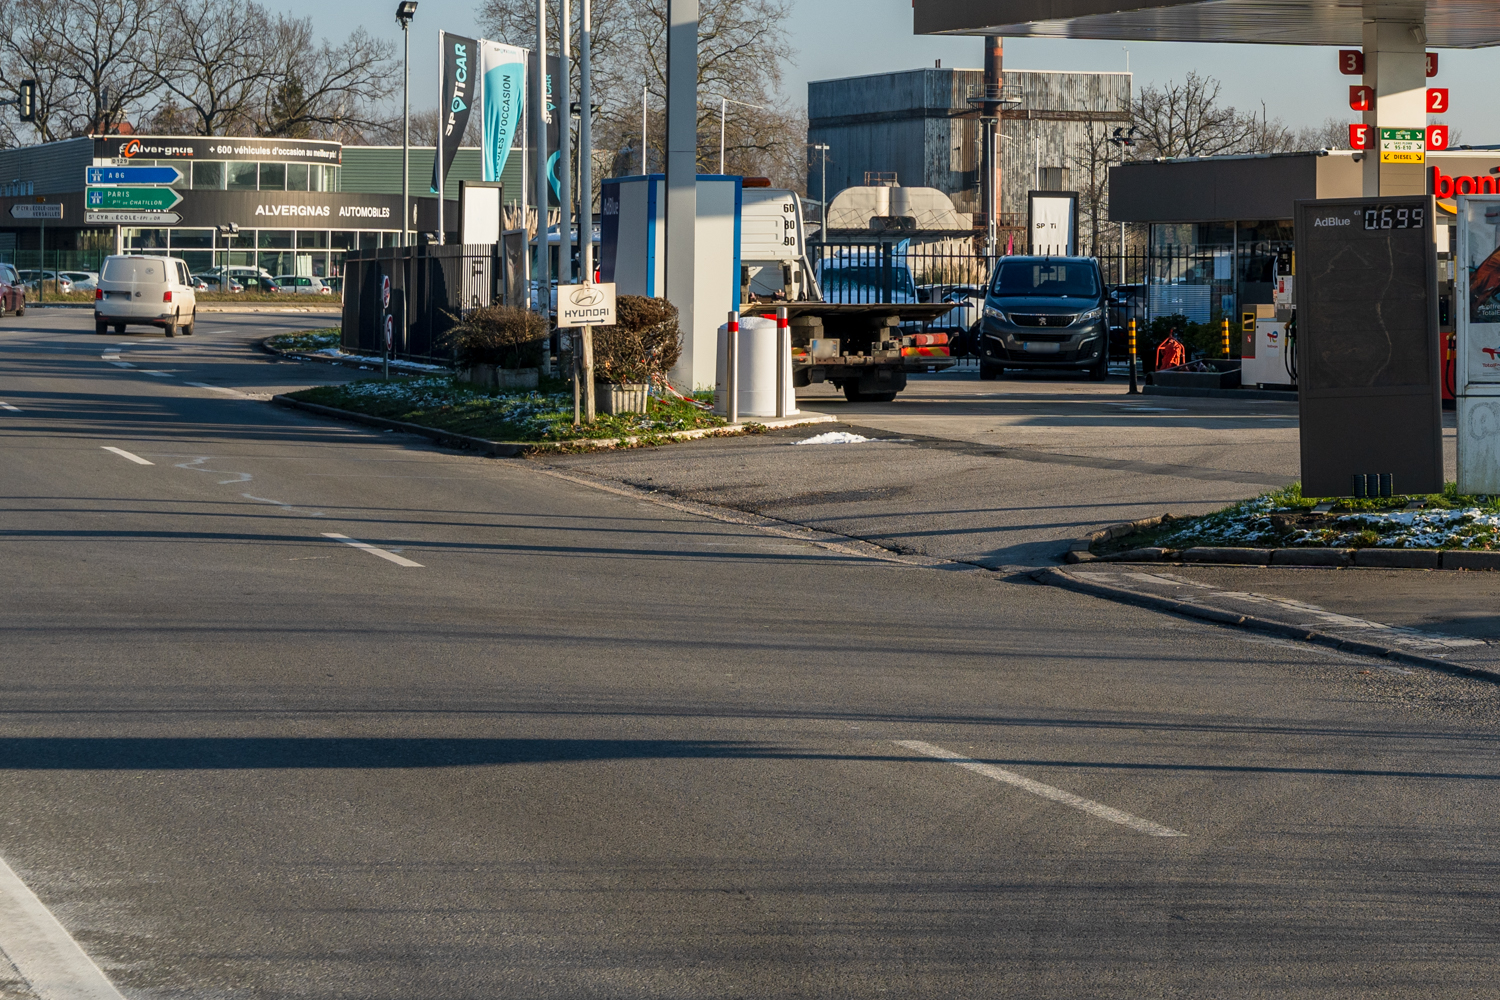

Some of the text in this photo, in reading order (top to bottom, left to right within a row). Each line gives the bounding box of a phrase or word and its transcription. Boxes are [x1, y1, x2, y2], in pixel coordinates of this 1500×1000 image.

[1346, 54, 1357, 71] 3
[1426, 56, 1433, 73] 4
[500, 74, 511, 136] D'OCCASION
[1357, 89, 1366, 107] 1
[1431, 92, 1443, 109] 2
[1356, 128, 1367, 145] 5
[1431, 129, 1442, 146] 6
[217, 145, 232, 154] 600
[233, 145, 271, 155] véhicules
[271, 146, 306, 156] d'occasion
[107, 190, 130, 198] PARIS
[255, 204, 390, 218] ALVERGNAS AUTOMOBILES
[783, 203, 795, 213] 60
[784, 220, 795, 230] 80
[1314, 217, 1351, 227] AdBlue
[1364, 208, 1424, 230] 0.699
[784, 236, 795, 246] 90
[564, 308, 610, 318] HYUNDAI
